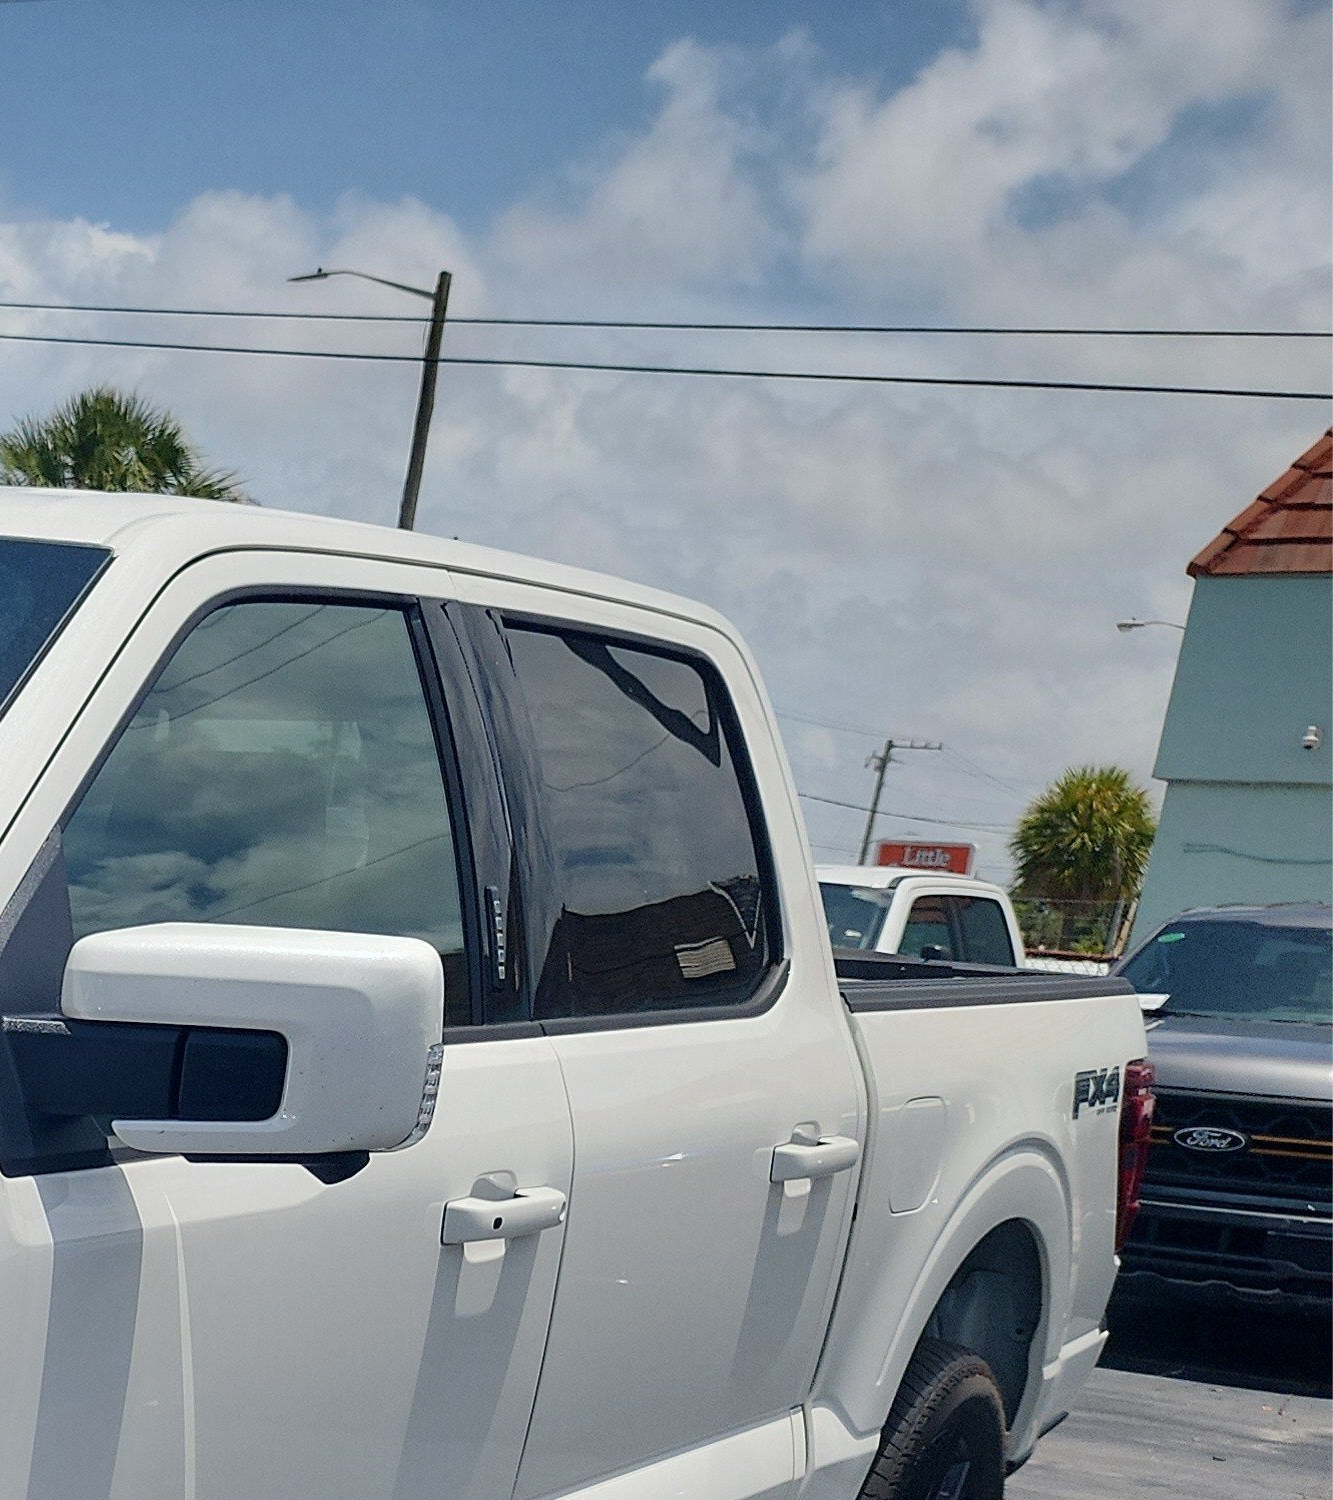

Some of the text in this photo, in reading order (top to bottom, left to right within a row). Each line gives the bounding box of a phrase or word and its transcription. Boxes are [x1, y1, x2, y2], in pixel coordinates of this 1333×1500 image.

[902, 845, 951, 867] Little
[1073, 1066, 1120, 1119] FX4
[1186, 1130, 1233, 1149] Ford
